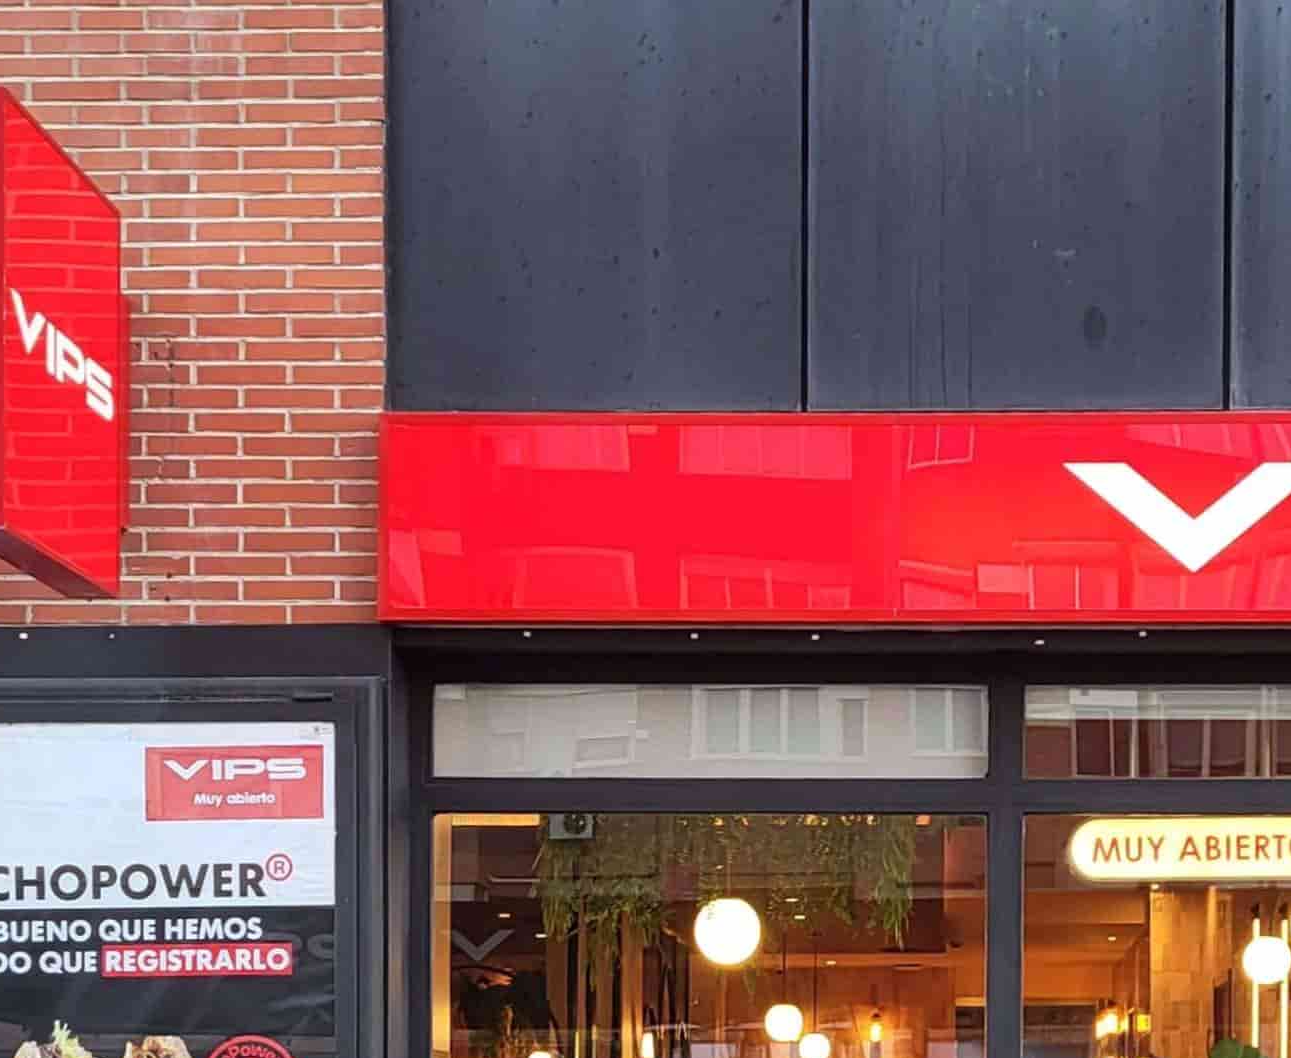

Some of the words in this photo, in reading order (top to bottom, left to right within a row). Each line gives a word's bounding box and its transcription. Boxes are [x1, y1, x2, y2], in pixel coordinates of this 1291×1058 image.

[11, 287, 115, 422] VIPS
[164, 757, 306, 781] VIPS
[194, 792, 223, 808] Muy
[227, 791, 276, 805] abierto
[1092, 836, 1165, 863] MUY
[99, 919, 156, 942] QUE
[164, 917, 262, 940] HEMOS
[39, 951, 97, 974] QUE
[106, 948, 291, 972] REGISTRARLO
